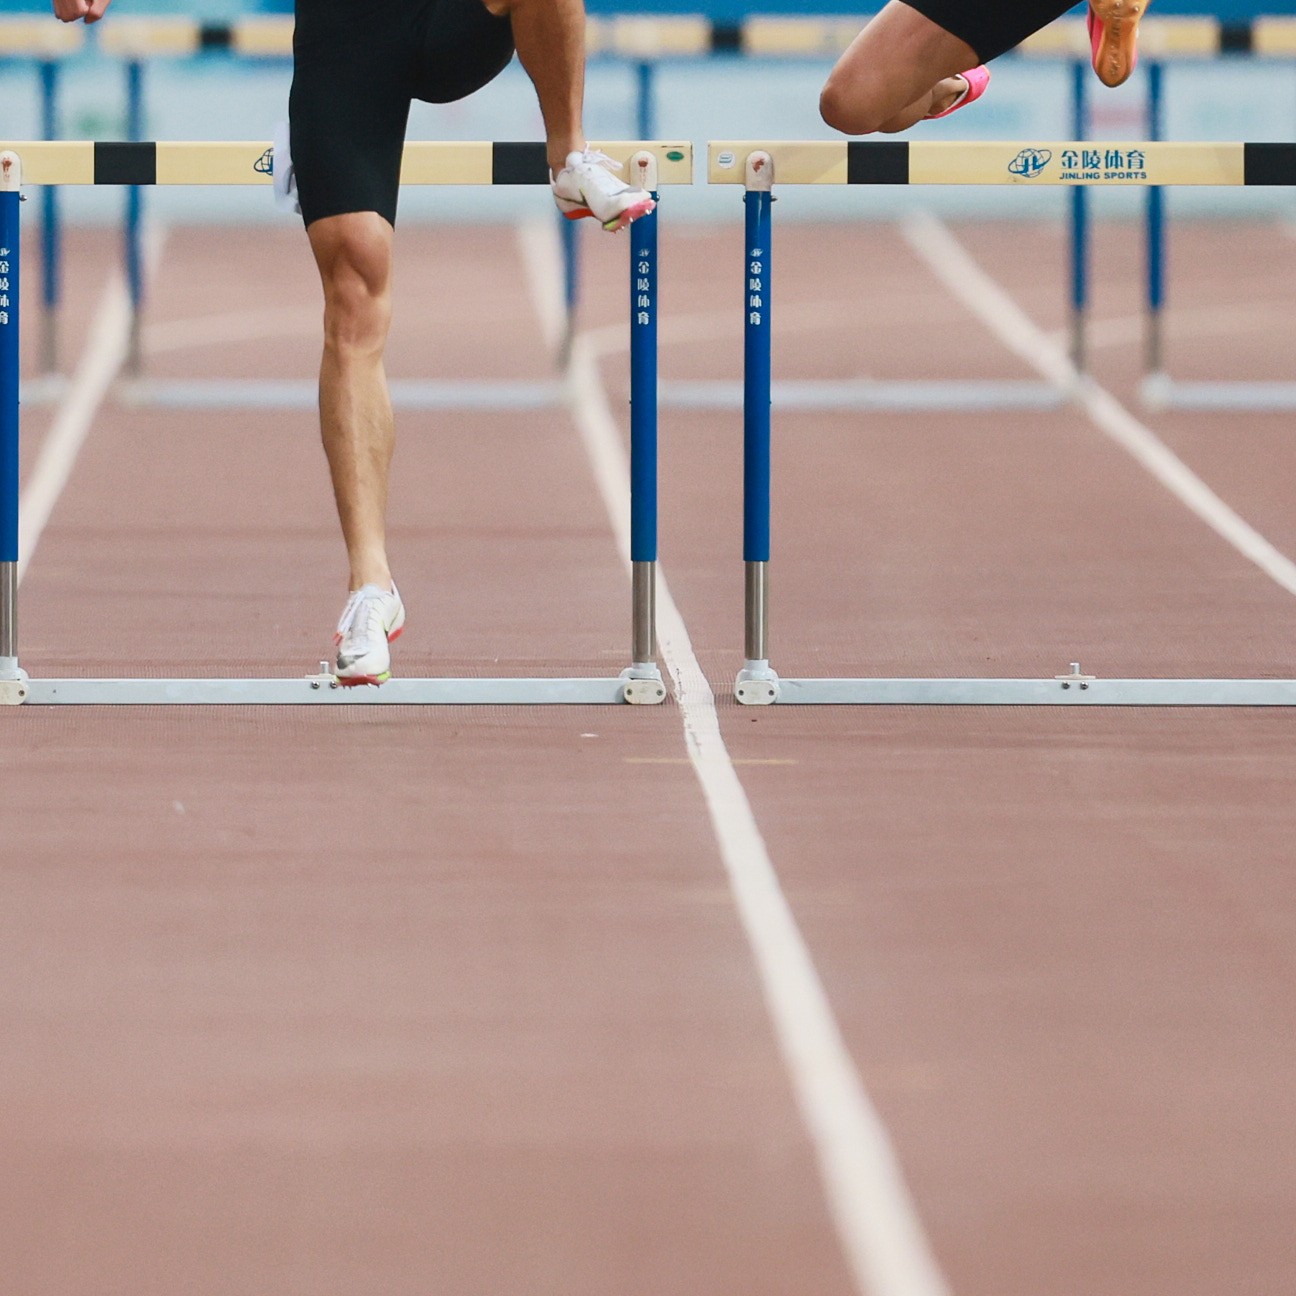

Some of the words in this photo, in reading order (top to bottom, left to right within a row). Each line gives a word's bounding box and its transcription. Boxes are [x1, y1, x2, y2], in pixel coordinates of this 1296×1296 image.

[1060, 150, 1146, 169] 金陵体育
[637, 261, 650, 325] 金陵体育
[749, 261, 761, 326] 金陵体育
